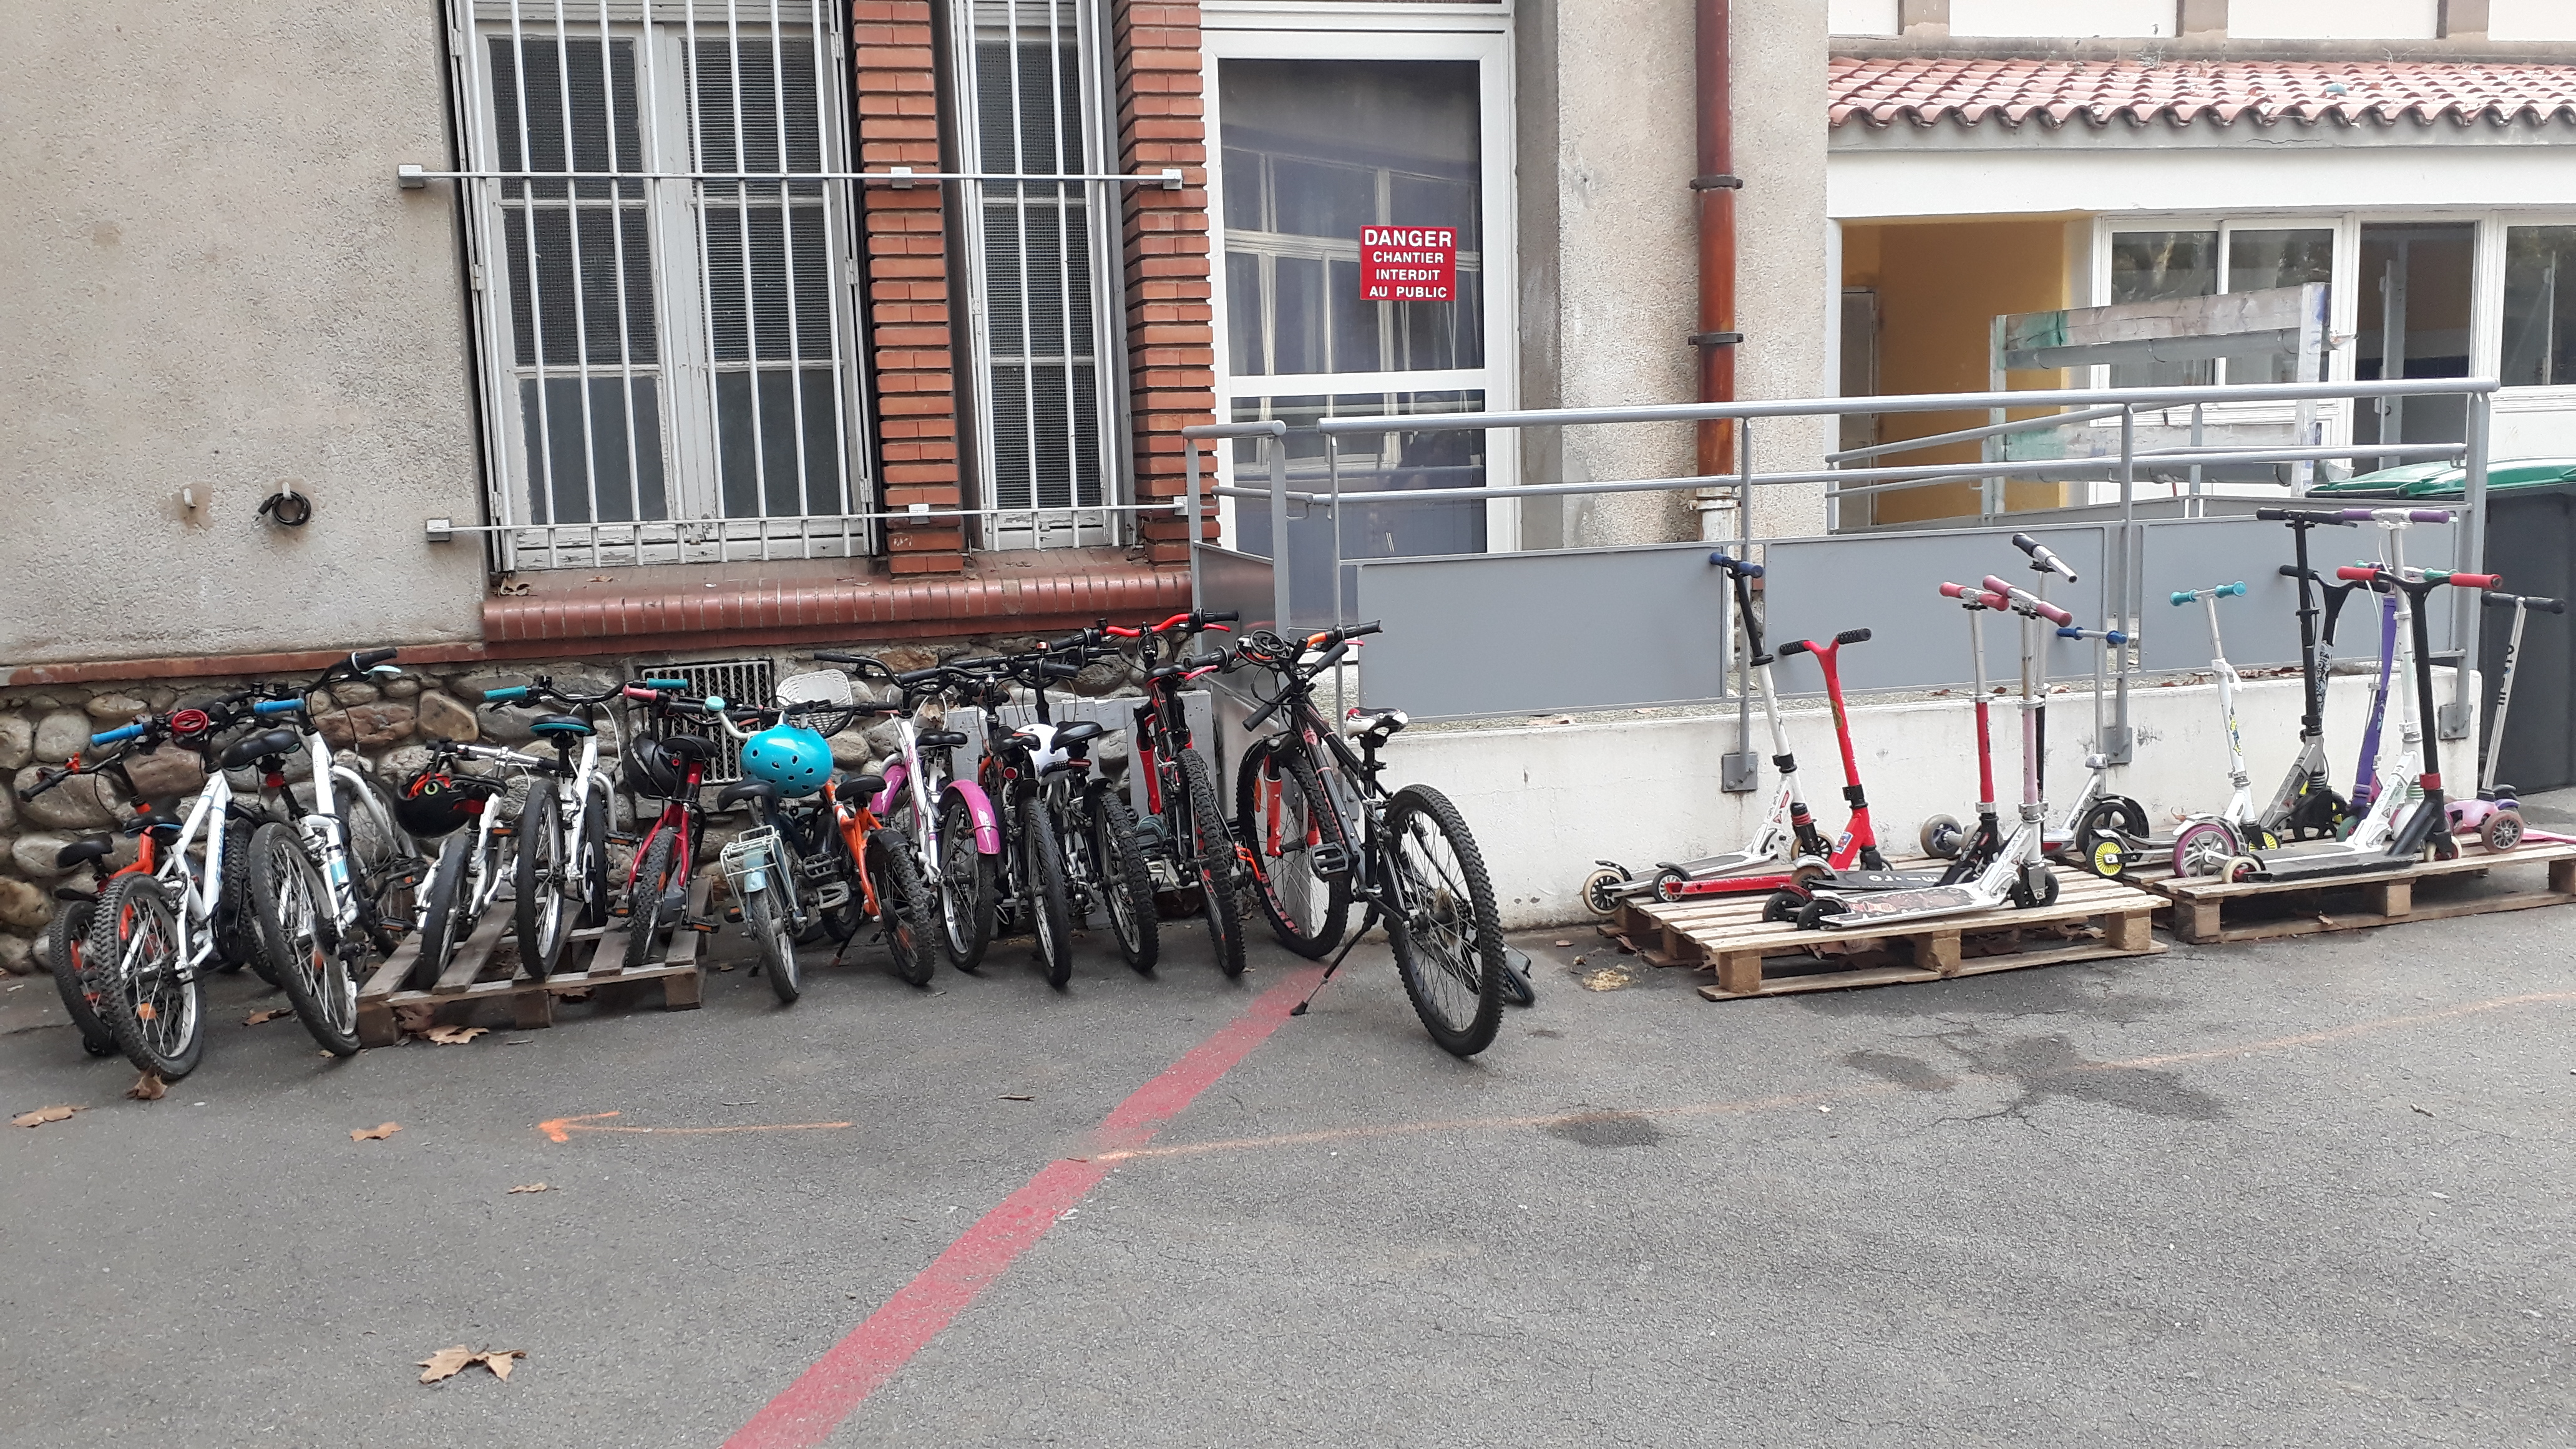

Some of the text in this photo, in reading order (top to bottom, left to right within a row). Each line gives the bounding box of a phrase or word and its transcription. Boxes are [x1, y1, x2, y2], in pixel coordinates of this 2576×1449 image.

[1365, 229, 1451, 247] DANGER
[1373, 251, 1444, 263] CHANTIER
[1376, 269, 1441, 281] INTERDIT
[1369, 286, 1447, 298] AU PUBLIC
